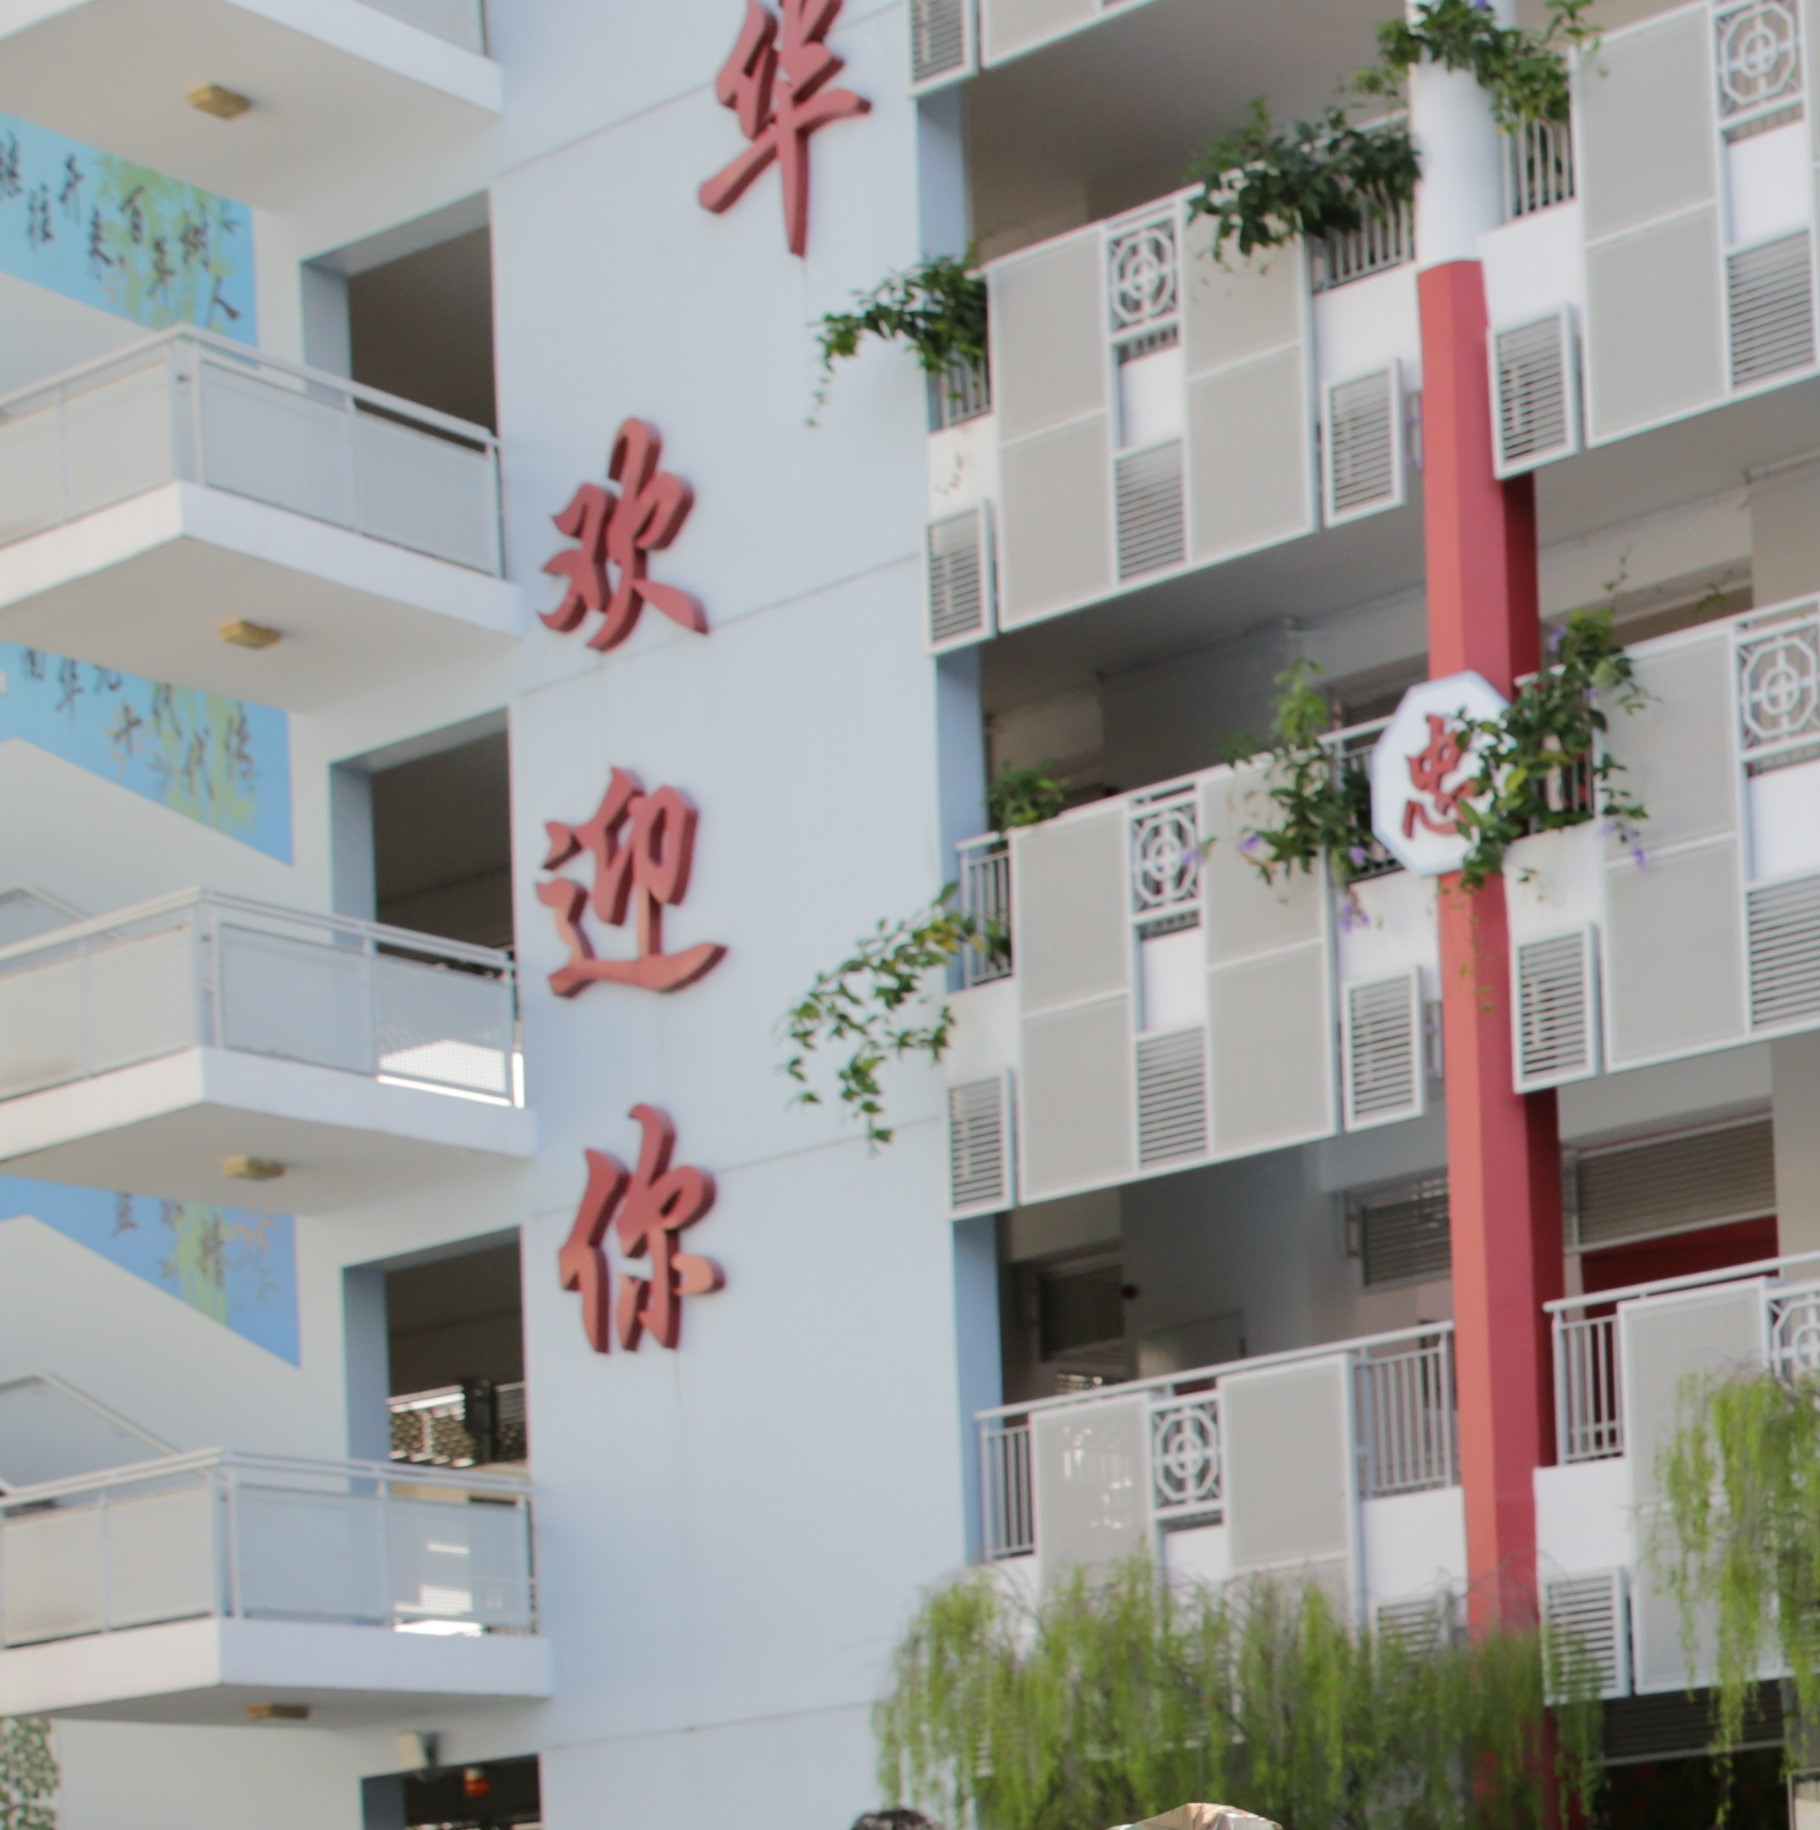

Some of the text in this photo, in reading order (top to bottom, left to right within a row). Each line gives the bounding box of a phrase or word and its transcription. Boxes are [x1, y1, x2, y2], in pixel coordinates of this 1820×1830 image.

[535, 416, 727, 1355] 欢迎你
[1403, 714, 1479, 839] 忠
